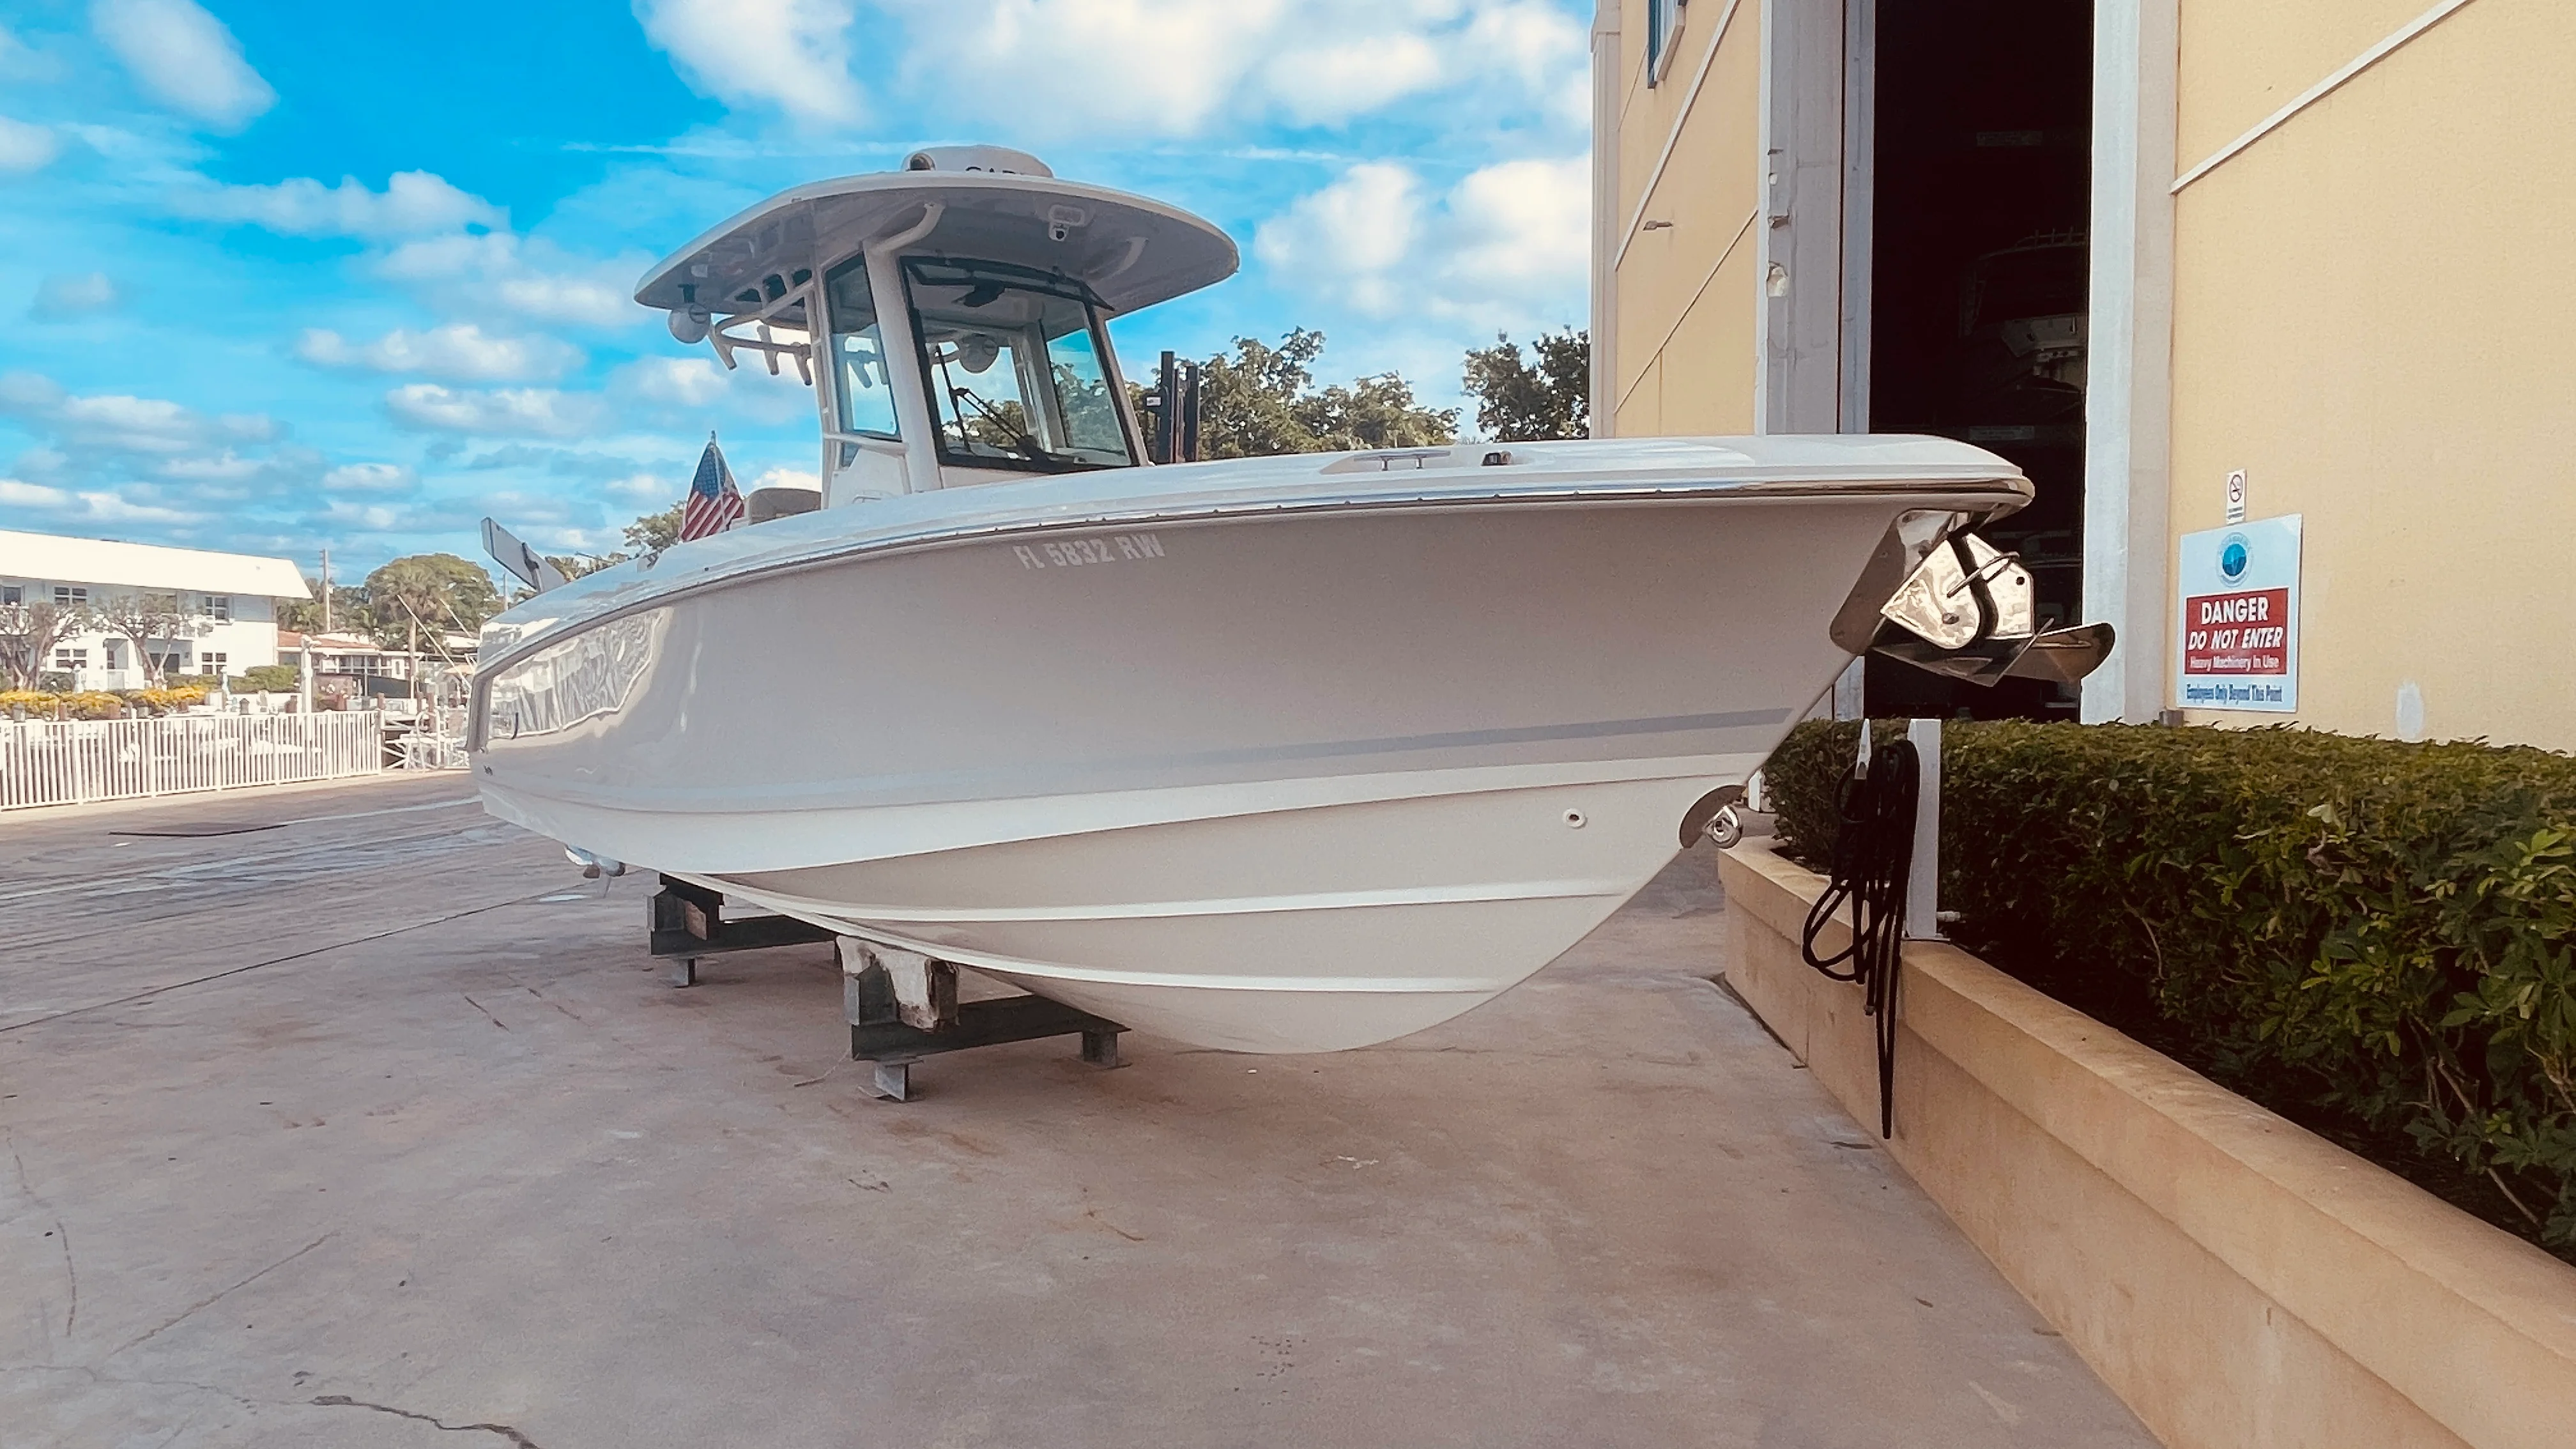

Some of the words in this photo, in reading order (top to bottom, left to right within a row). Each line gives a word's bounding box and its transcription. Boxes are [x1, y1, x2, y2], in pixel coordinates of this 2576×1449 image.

[1013, 546, 1045, 570] FL
[1043, 539, 1116, 567] 5832
[1114, 533, 1165, 560] RW
[2201, 597, 2269, 625] DANGER
[2188, 631, 2207, 650] DO
[2211, 629, 2239, 650] NOT
[2241, 627, 2283, 649] ENTER
[2213, 655, 2251, 671] Machinery
[2253, 655, 2262, 668] In
[2263, 654, 2280, 668] Use
